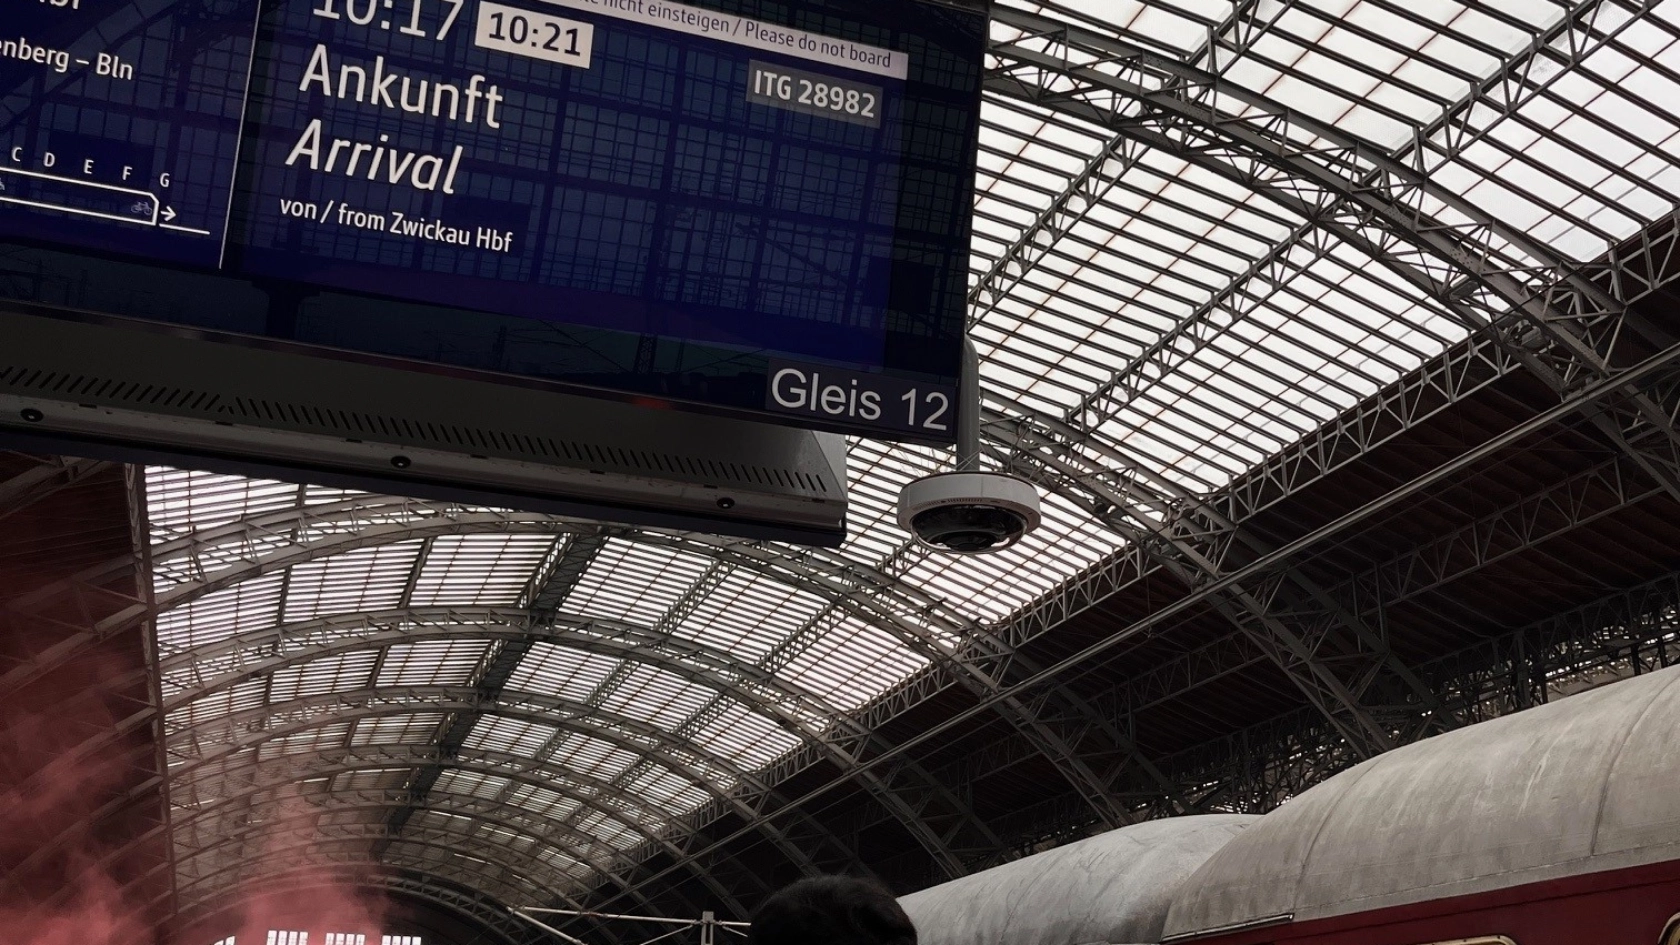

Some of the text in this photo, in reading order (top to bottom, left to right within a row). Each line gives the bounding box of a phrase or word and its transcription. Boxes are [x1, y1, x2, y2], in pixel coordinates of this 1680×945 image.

[0, 37, 69, 73] nberg
[96, 51, 133, 80] Bln
[488, 12, 581, 56] 10:21
[648, 4, 730, 33] einsteigen
[745, 21, 794, 47] Please
[798, 34, 817, 52] do
[820, 42, 846, 58] not
[850, 44, 891, 68] board
[299, 43, 503, 129] Ankunft
[754, 69, 875, 118] ITG 28982
[11, 147, 170, 188] C D E F G
[285, 118, 463, 194] Arrival
[280, 199, 317, 220] von
[338, 203, 385, 231] from
[389, 211, 470, 246] Zwickau
[475, 226, 514, 253] Hbf
[771, 368, 949, 431] Gleis 12
